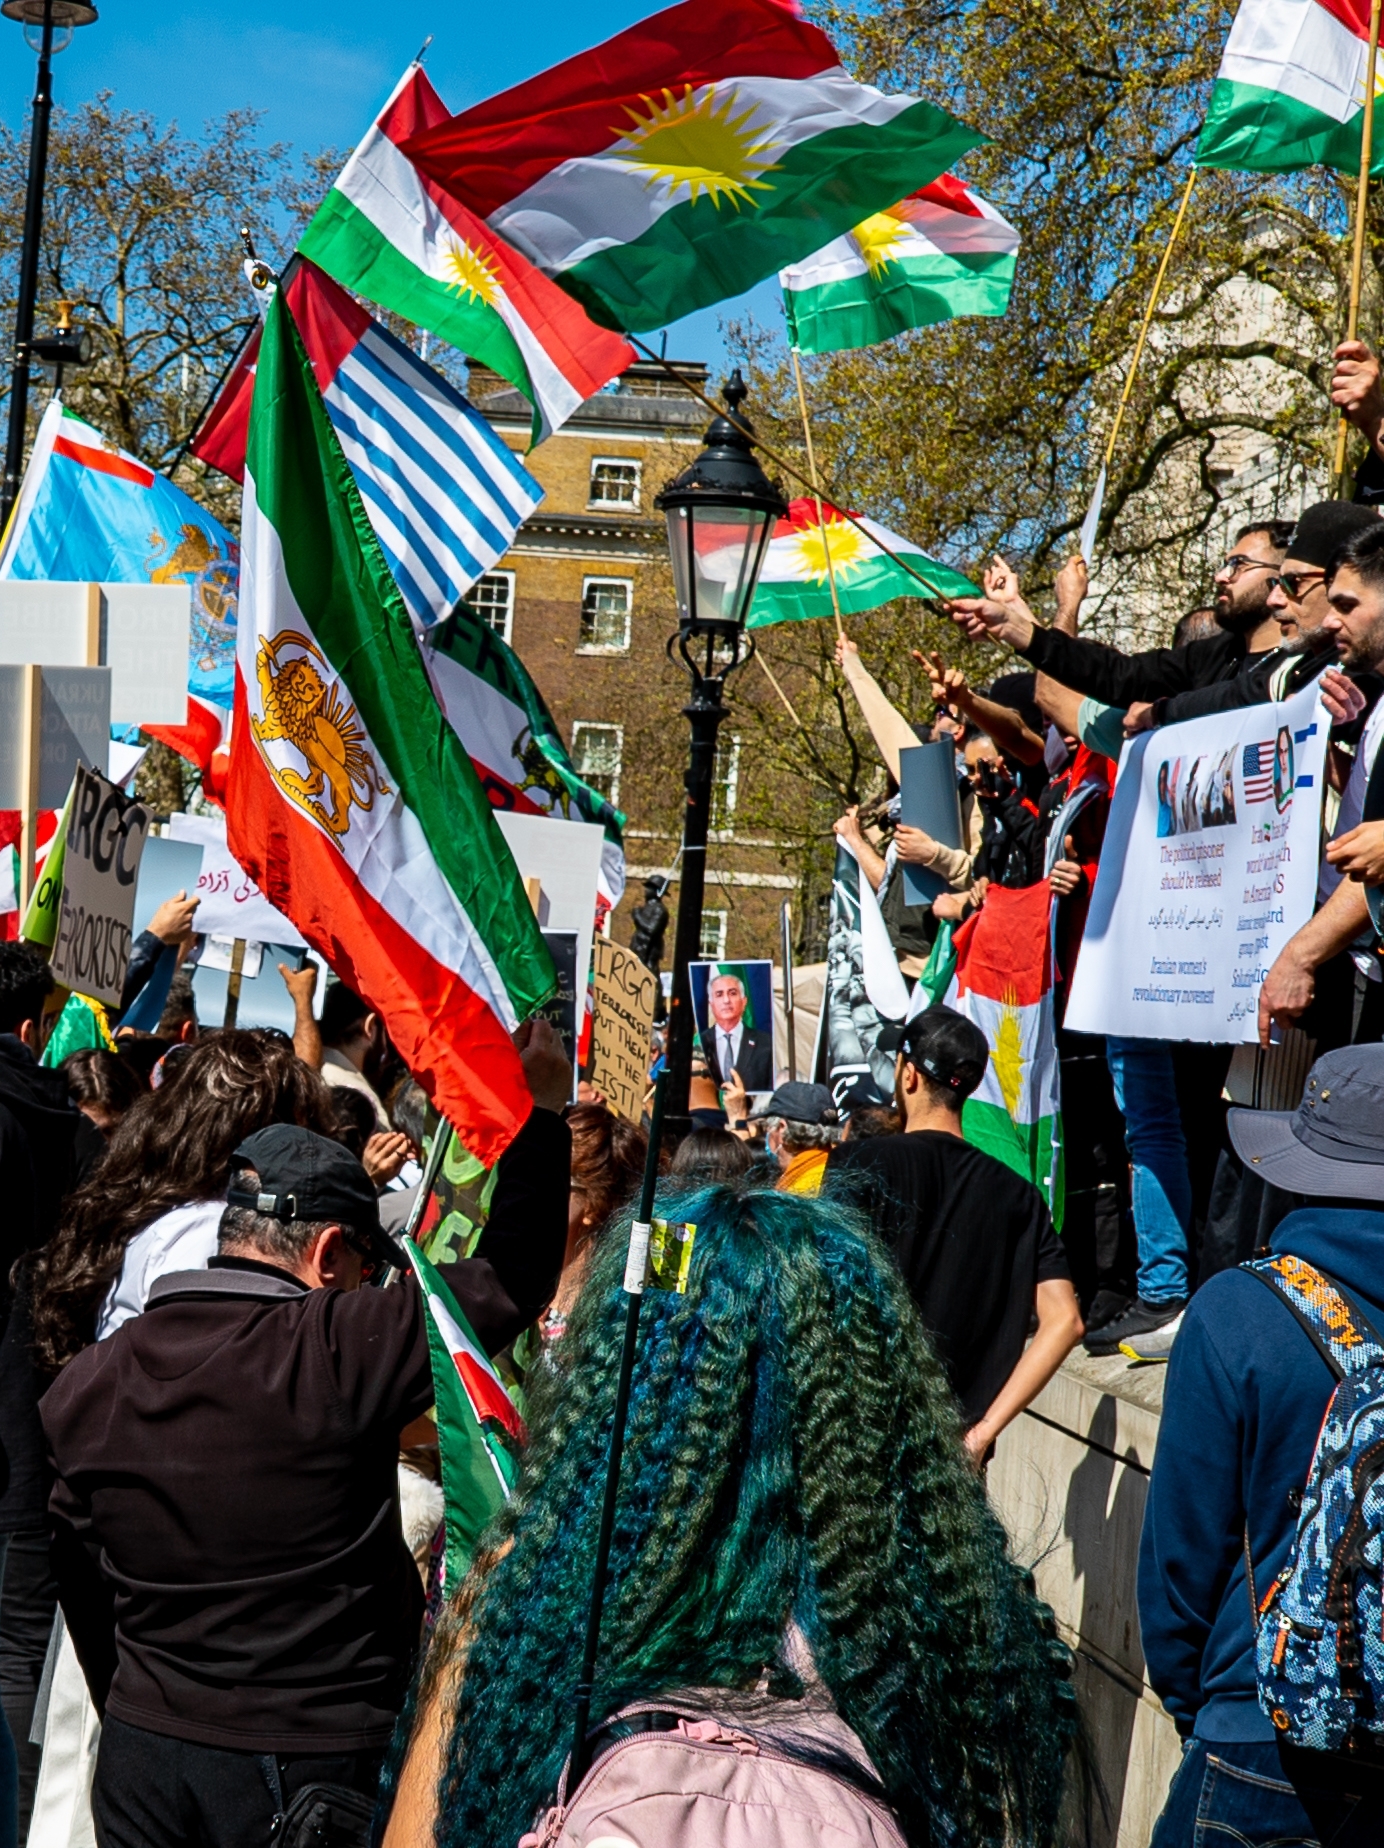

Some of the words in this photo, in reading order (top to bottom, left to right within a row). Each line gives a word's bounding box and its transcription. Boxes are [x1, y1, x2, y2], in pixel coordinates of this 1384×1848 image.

[65, 765, 147, 887] IRGC
[196, 868, 232, 894] آزاد
[596, 938, 654, 1017] IRGC
[592, 1008, 615, 1034] PUT
[618, 1024, 647, 1070] THEM
[592, 1037, 612, 1058] ON
[615, 1054, 642, 1086] THE
